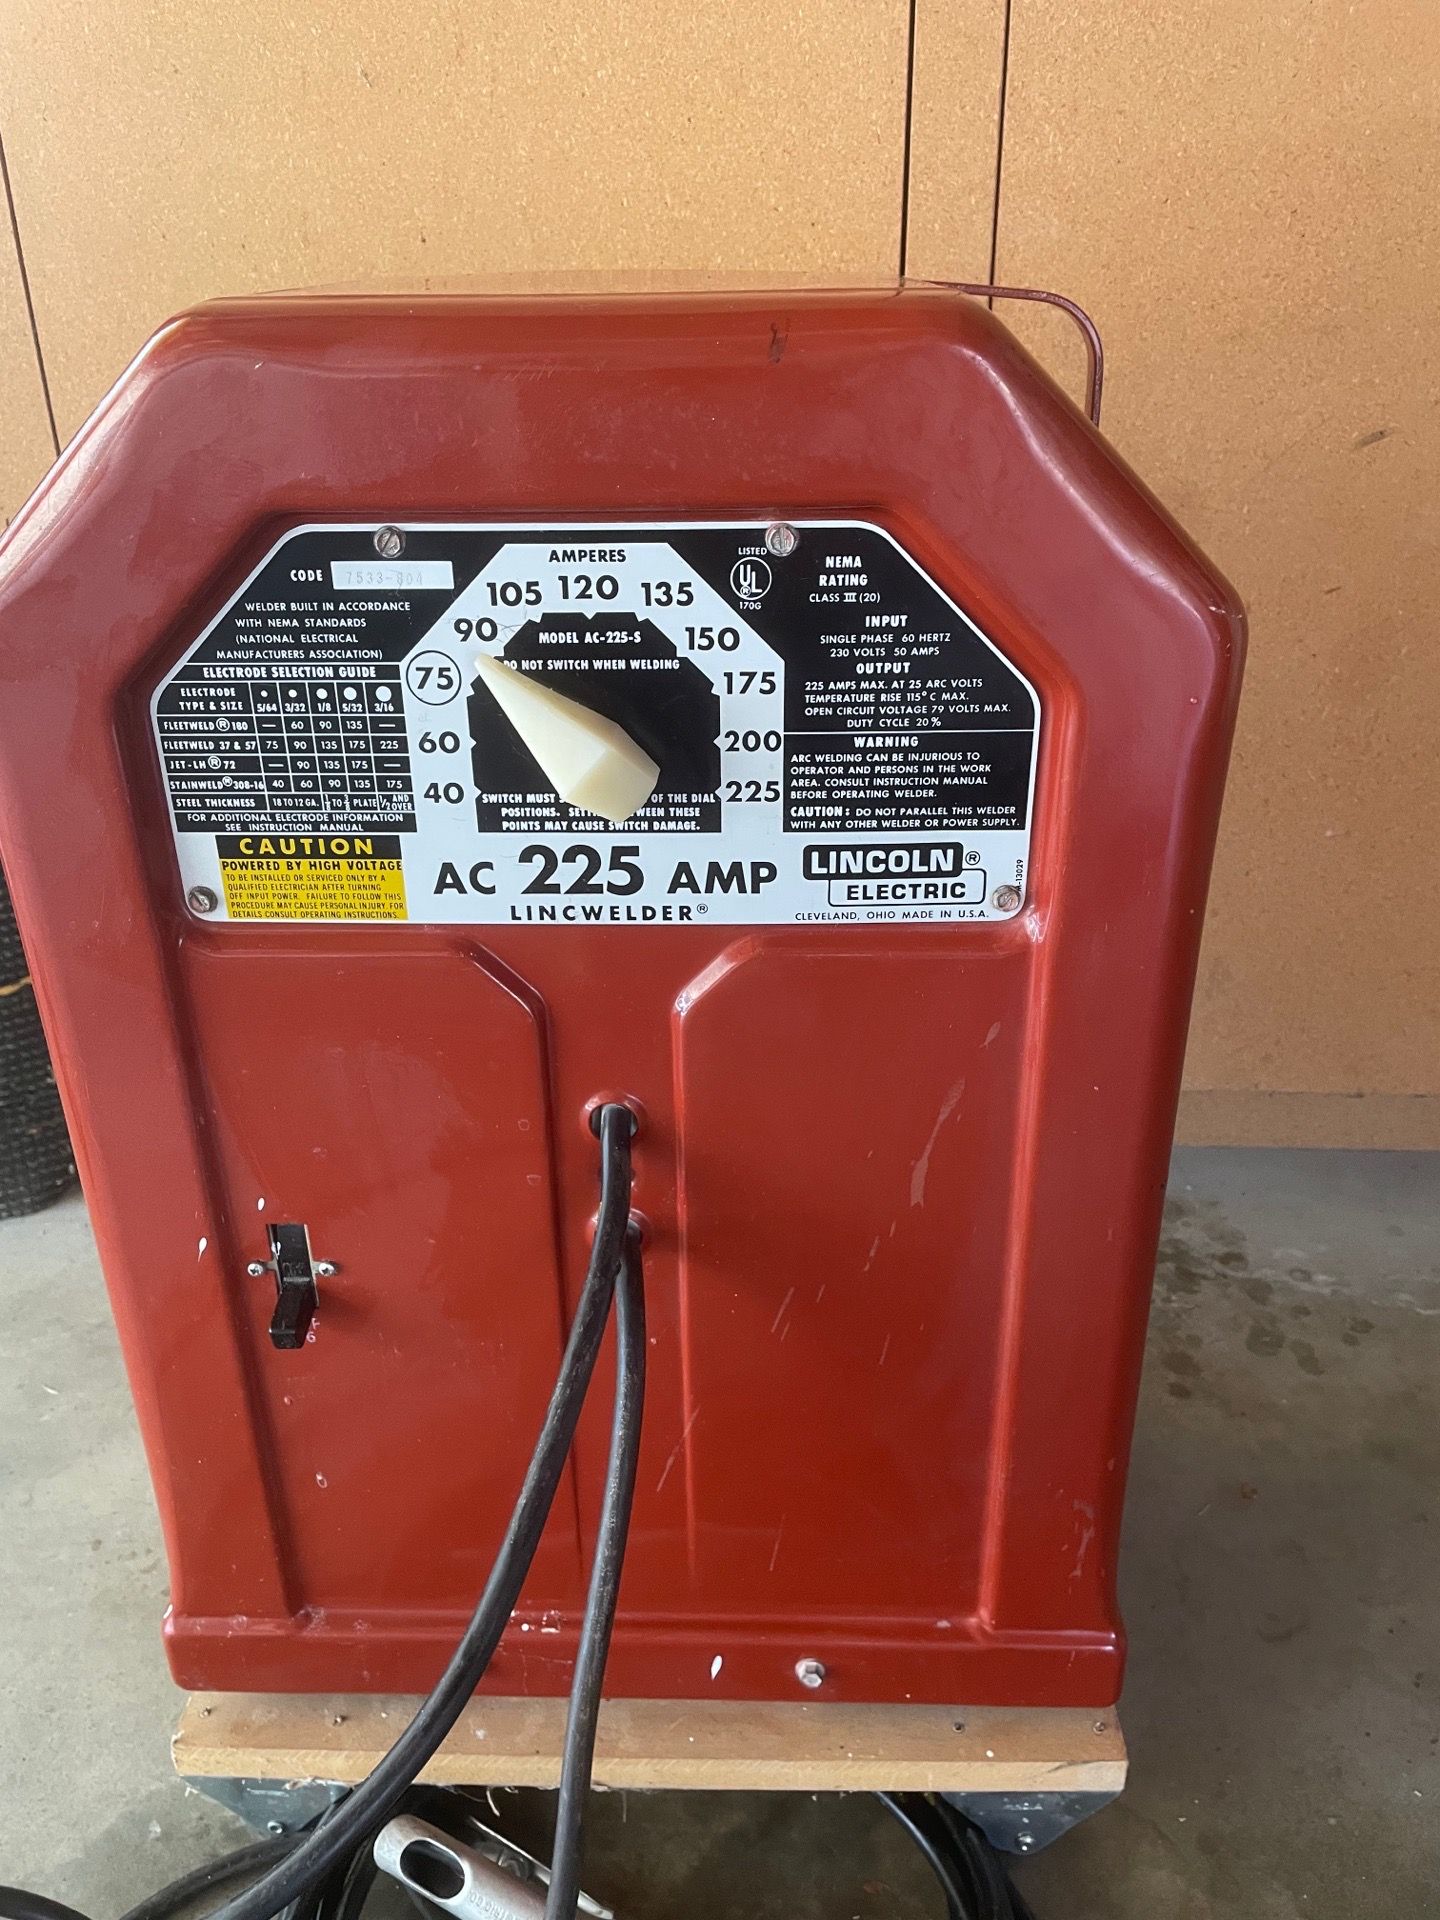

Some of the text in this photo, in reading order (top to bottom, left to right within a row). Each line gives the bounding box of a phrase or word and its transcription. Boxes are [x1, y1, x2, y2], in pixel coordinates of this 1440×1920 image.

[549, 549, 626, 563] AMPERES
[738, 547, 767, 555] LISTED
[826, 556, 861, 568] NEMA
[290, 570, 322, 581] CODE
[819, 574, 867, 586] RATING
[558, 574, 618, 600] 120
[486, 581, 542, 606] 105
[641, 582, 693, 606] 135
[809, 592, 880, 603] CLASS III (20)
[244, 602, 410, 611] WELDER BUILT IN ACCORDANCE
[740, 602, 761, 610] 170G
[235, 618, 366, 627] WITH NEMA STANDARDS
[866, 615, 907, 627] INPUT
[454, 617, 498, 642] 90
[236, 634, 358, 643] (NATIONAL ELECTRICAL
[539, 631, 641, 643] MODEL AC-225-S
[685, 627, 740, 651] 150
[820, 633, 950, 644] SINGLE PHASE 60 HERTZ
[216, 649, 382, 659] MANUFACTURERS ASSOCIATION)
[830, 646, 939, 657] 230 VOLTS 50 AMPS
[521, 660, 543, 670] NOT
[547, 660, 588, 670] SWITCH
[592, 659, 625, 669] WHEN
[630, 659, 679, 669] WELDING
[856, 662, 910, 674] OUTPUT
[203, 666, 376, 678] ELECTRODE SELECTION GUIDE
[416, 666, 454, 690] 75
[724, 671, 776, 694] 175
[805, 678, 982, 690] 225 AMPS MAX. AT 25 ARC VOLTS
[180, 687, 235, 697] ELECTRODE
[805, 690, 968, 703] TEMPERATURE RISE 115° C MAX.
[179, 701, 394, 714] TYPE & SIZE 5/64 3/32 1/8 5/32 3/16
[804, 704, 1010, 715] OPEN CIRCUIT VOLTAGE 79 VOLTS MAX.
[847, 716, 941, 728] DUTY CYCLE 20%
[164, 740, 398, 750] FLEETWELD 37 & 57 75 90 135 175 225
[418, 731, 460, 753] 60
[724, 730, 782, 752] 200
[854, 736, 918, 747] WARNING
[790, 752, 980, 762] ARC WELDING CAN BE INJURIOUS TO
[790, 766, 843, 775] OPERATOR
[848, 766, 870, 774] AND
[874, 765, 918, 773] PERSONS
[938, 764, 955, 772] THE
[960, 764, 991, 772] WORK
[790, 776, 987, 787] AREA. CONSULT INSTRUCTION MANUAL
[424, 782, 464, 804] 40
[726, 780, 781, 802] 225
[790, 789, 936, 799] BEFORE OPERATING WELDER.
[480, 794, 522, 803] SWITCH
[526, 793, 555, 803] MUST
[650, 793, 715, 803] OF THE DIAL
[856, 808, 871, 816] DO
[875, 807, 896, 816] NOT
[900, 807, 948, 815] PARALLEL
[952, 806, 972, 815] THIS
[976, 806, 1015, 814] WELDER
[502, 821, 700, 831] POINTS MAY CAUSE SWITCH DAMAGE.
[790, 818, 1019, 829] WITH ANY OTHER WELDER OR POWER SUPPLY.
[240, 838, 372, 854] CAUTION
[222, 860, 402, 871] POWERED BY HIGH VOLTAGE
[811, 848, 953, 874] LINCOLN
[434, 844, 777, 895] AC 225 AMP
[847, 882, 965, 901] ELECTRIC
[795, 909, 988, 920] CLEVELAND, OHIO MADE IN U.S.A.
